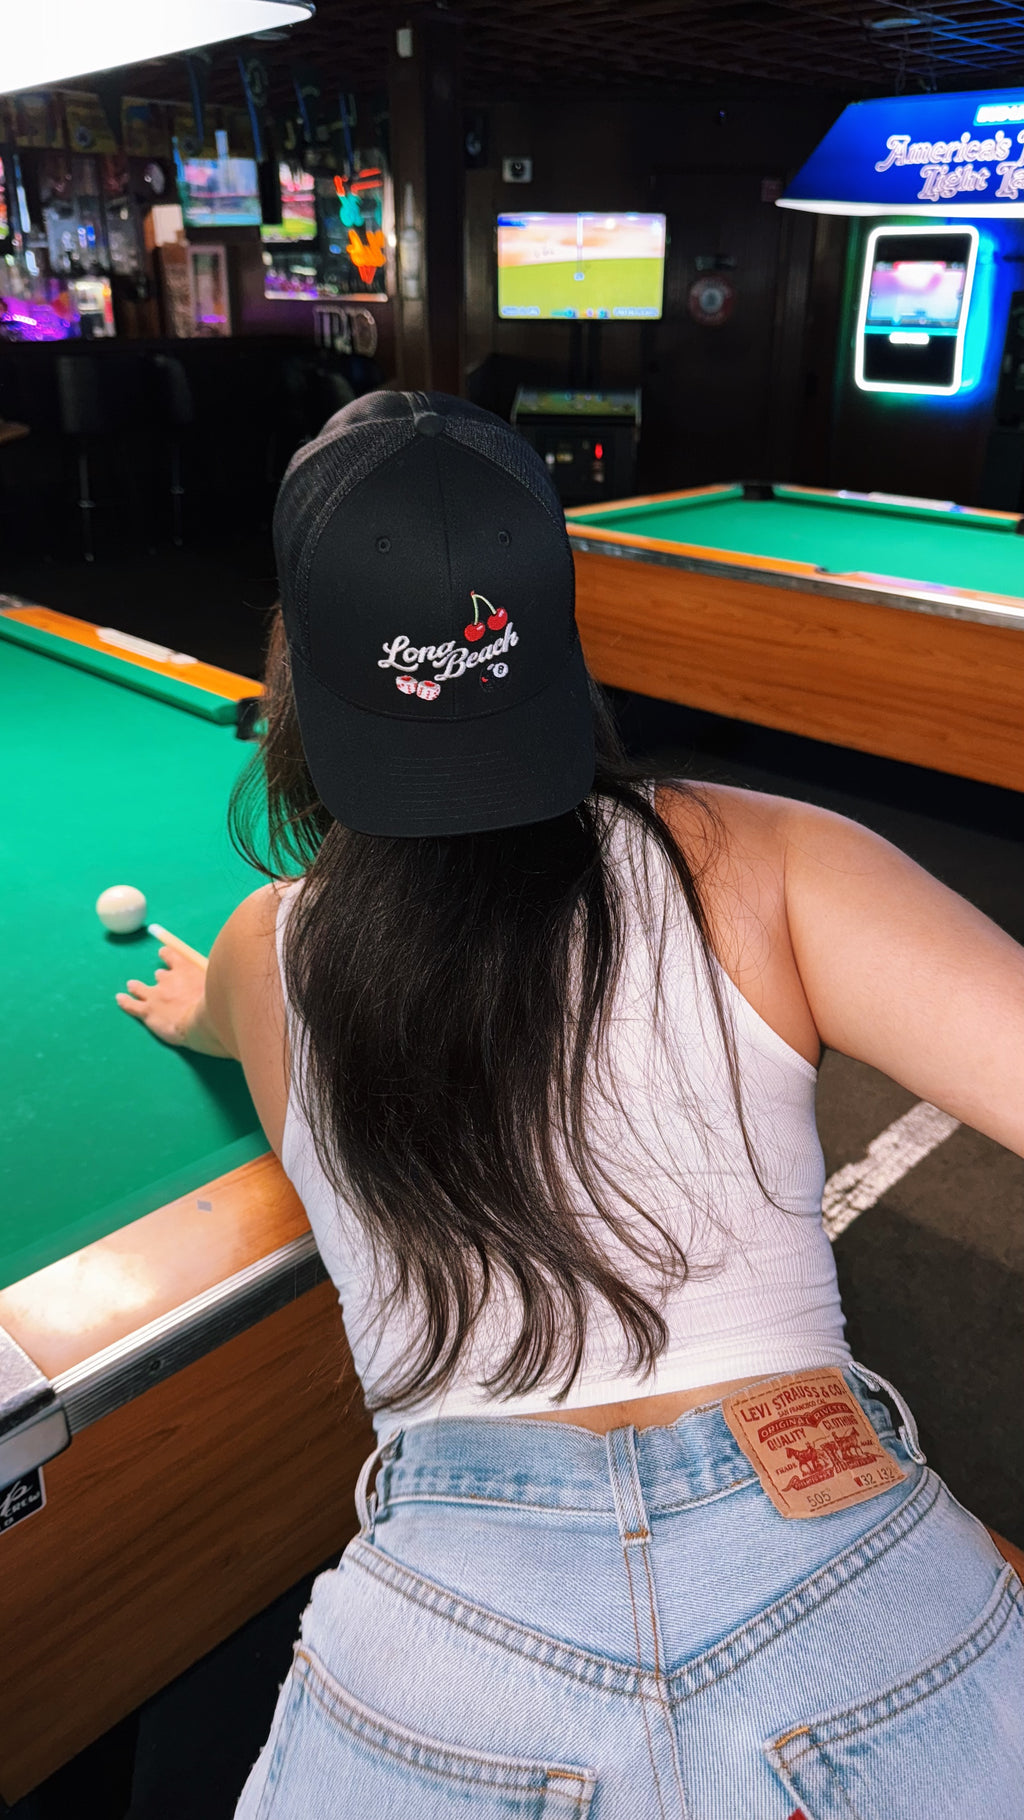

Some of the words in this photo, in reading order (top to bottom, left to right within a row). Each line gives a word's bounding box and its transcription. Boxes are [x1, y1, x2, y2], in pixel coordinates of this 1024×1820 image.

[875, 130, 1012, 172] America's
[378, 635, 456, 672] Long
[434, 622, 519, 681] Beach
[740, 1402, 772, 1422] LEVI
[772, 1385, 820, 1410] STRAUSS
[820, 1386, 830, 1398] &
[777, 1409, 790, 1418] SAN
[789, 1400, 817, 1414] FRANCISCO
[761, 1416, 812, 1438] ORIGINAL
[766, 1427, 806, 1451] QUALITY
[822, 1414, 859, 1431] CLOTHING
